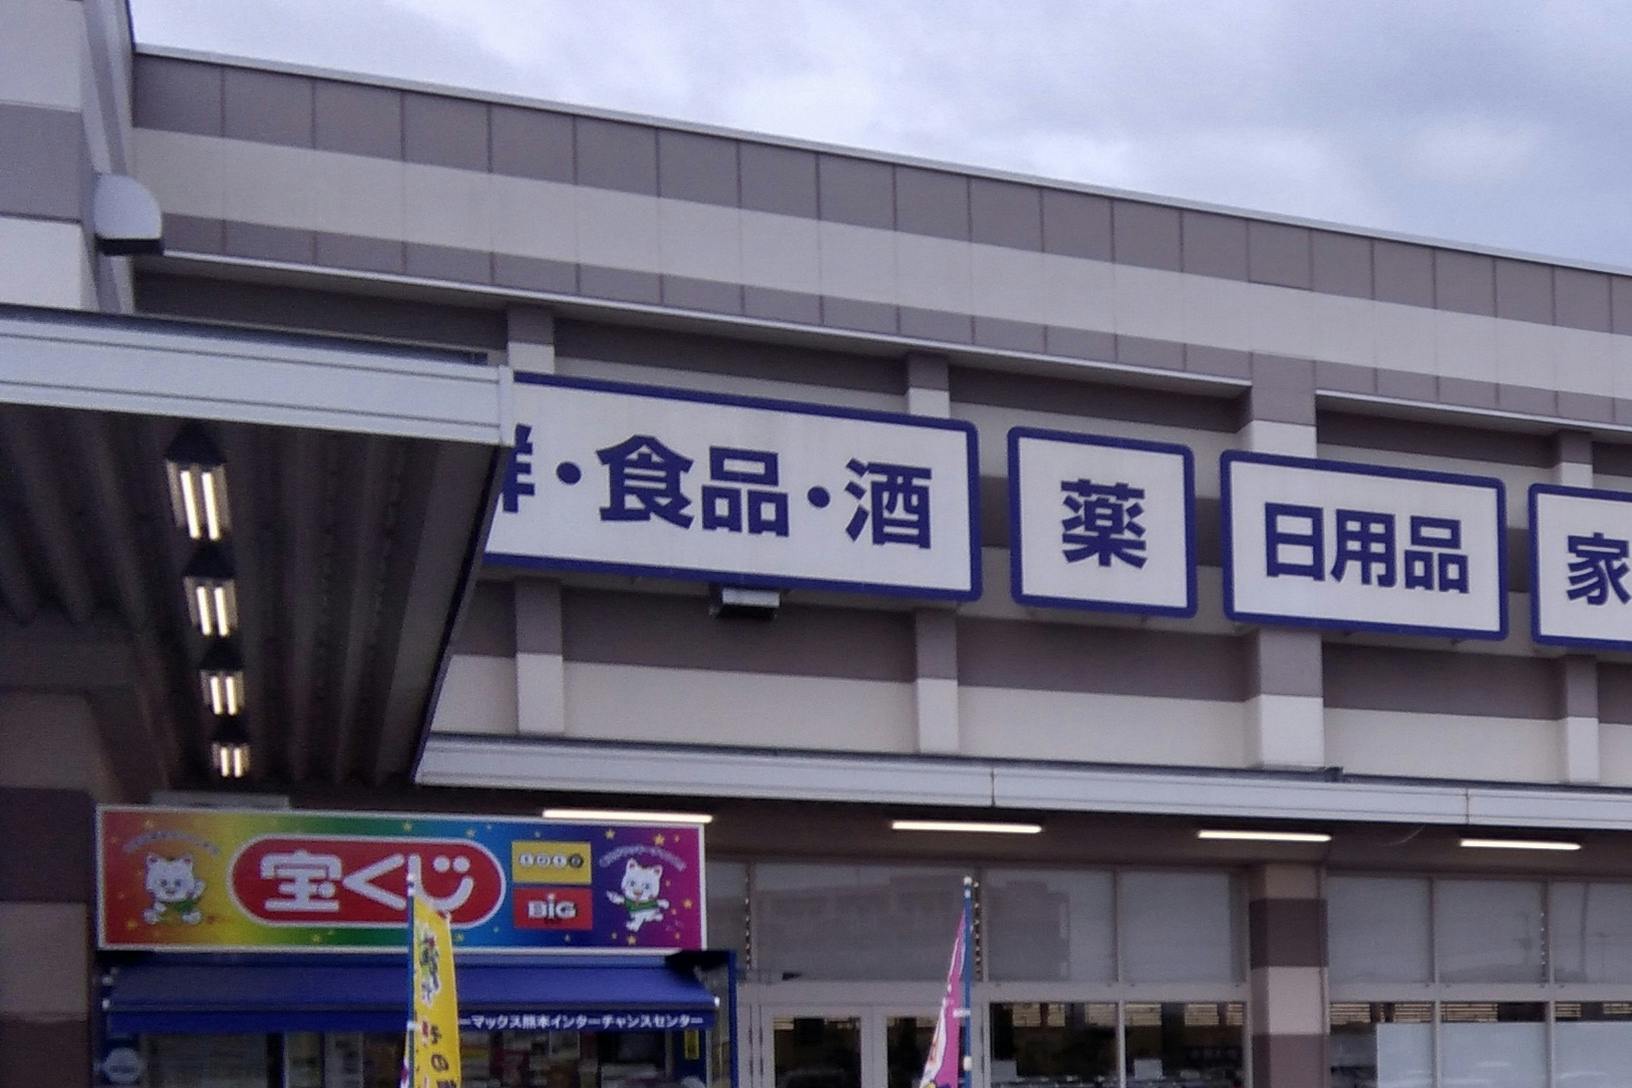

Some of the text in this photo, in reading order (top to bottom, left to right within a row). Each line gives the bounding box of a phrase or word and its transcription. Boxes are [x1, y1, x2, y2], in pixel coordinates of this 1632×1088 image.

[1061, 479, 1148, 568] 薬
[1264, 502, 1469, 594] 日用品
[261, 850, 476, 912] 宝くじ
